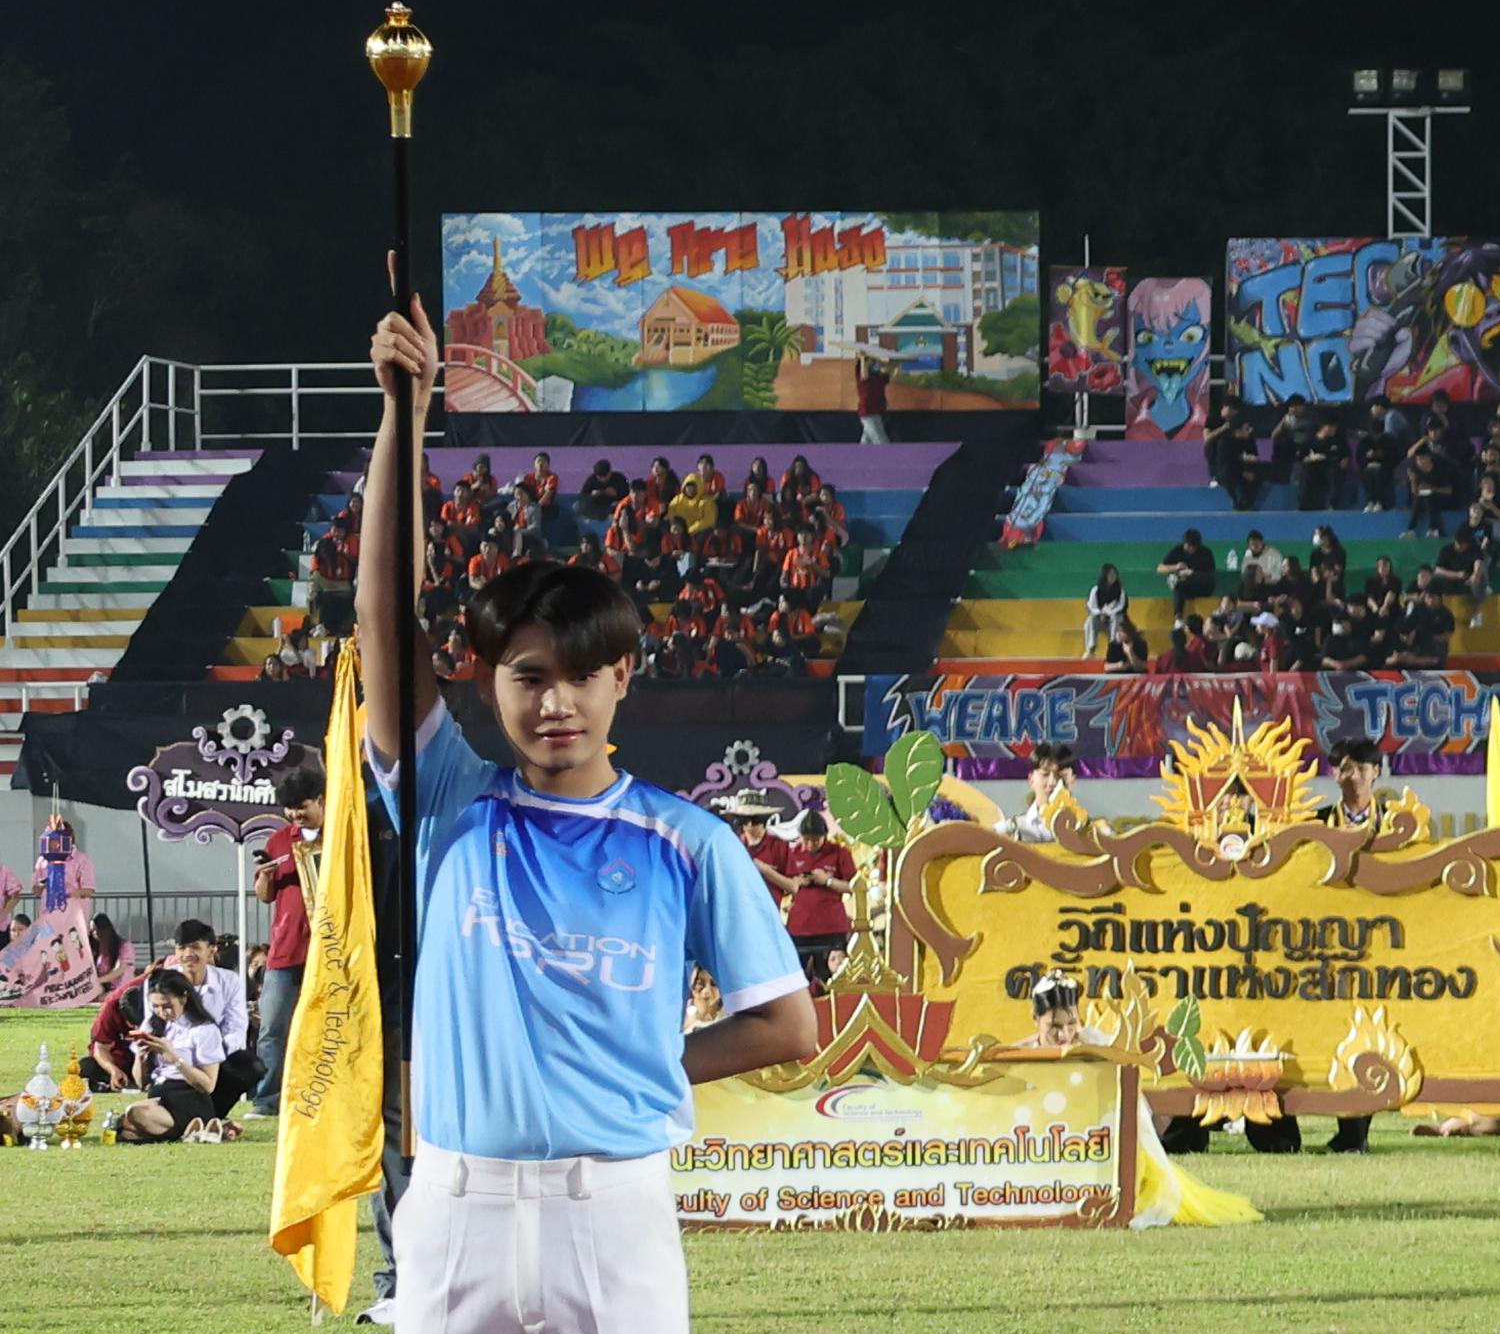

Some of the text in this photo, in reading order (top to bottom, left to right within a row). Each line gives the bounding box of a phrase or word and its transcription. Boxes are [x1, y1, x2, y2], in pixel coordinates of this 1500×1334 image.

[740, 1187, 769, 1212] of
[777, 1184, 886, 1211] Science
[894, 1182, 946, 1208] and
